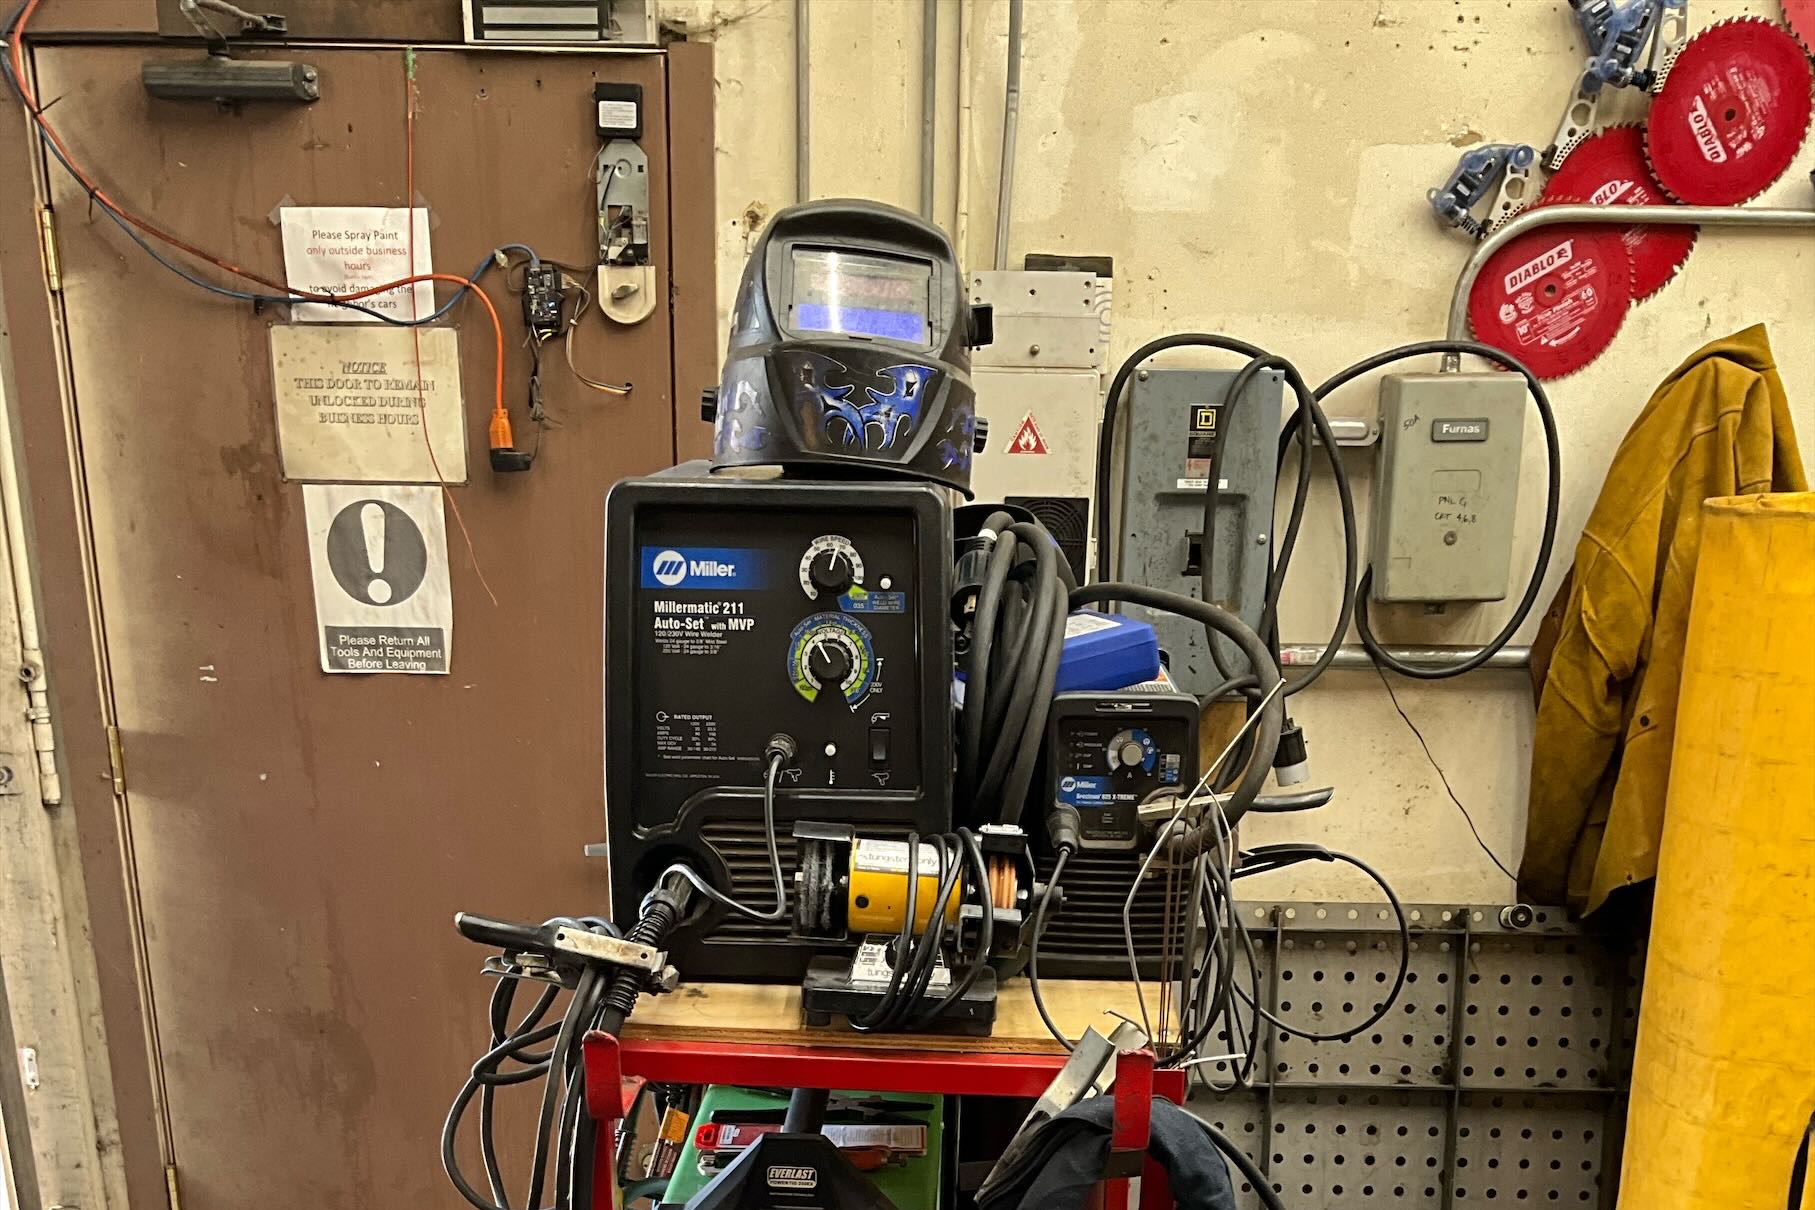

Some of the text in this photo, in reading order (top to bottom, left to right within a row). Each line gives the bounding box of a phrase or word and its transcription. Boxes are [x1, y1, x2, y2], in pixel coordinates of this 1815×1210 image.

[1693, 114, 1721, 161] DIABLO
[1594, 183, 1618, 205] BLO
[312, 229, 398, 243] Please Spray Paint
[306, 246, 407, 257] only outside business
[344, 260, 371, 270] hours
[1509, 254, 1555, 289] DIABLO
[309, 284, 320, 293] to
[397, 285, 413, 294] the
[378, 301, 398, 309] cars
[342, 361, 387, 374] NOTICE
[294, 377, 435, 391] THIS DOOR TO REMAIN
[309, 395, 426, 408] UNLOCKED DURING
[377, 413, 420, 425] HOURS
[1442, 424, 1481, 434] Furnas
[690, 560, 735, 577] Miller
[654, 600, 744, 614] Millermatic 211
[711, 622, 727, 630] with
[727, 618, 755, 631] MVP
[339, 635, 430, 646] Please Return All
[330, 646, 442, 661] Tools And Equipment
[347, 658, 427, 671] Before Leaving
[1076, 781, 1097, 789] Miller
[769, 1168, 815, 1180] EVERLAST
